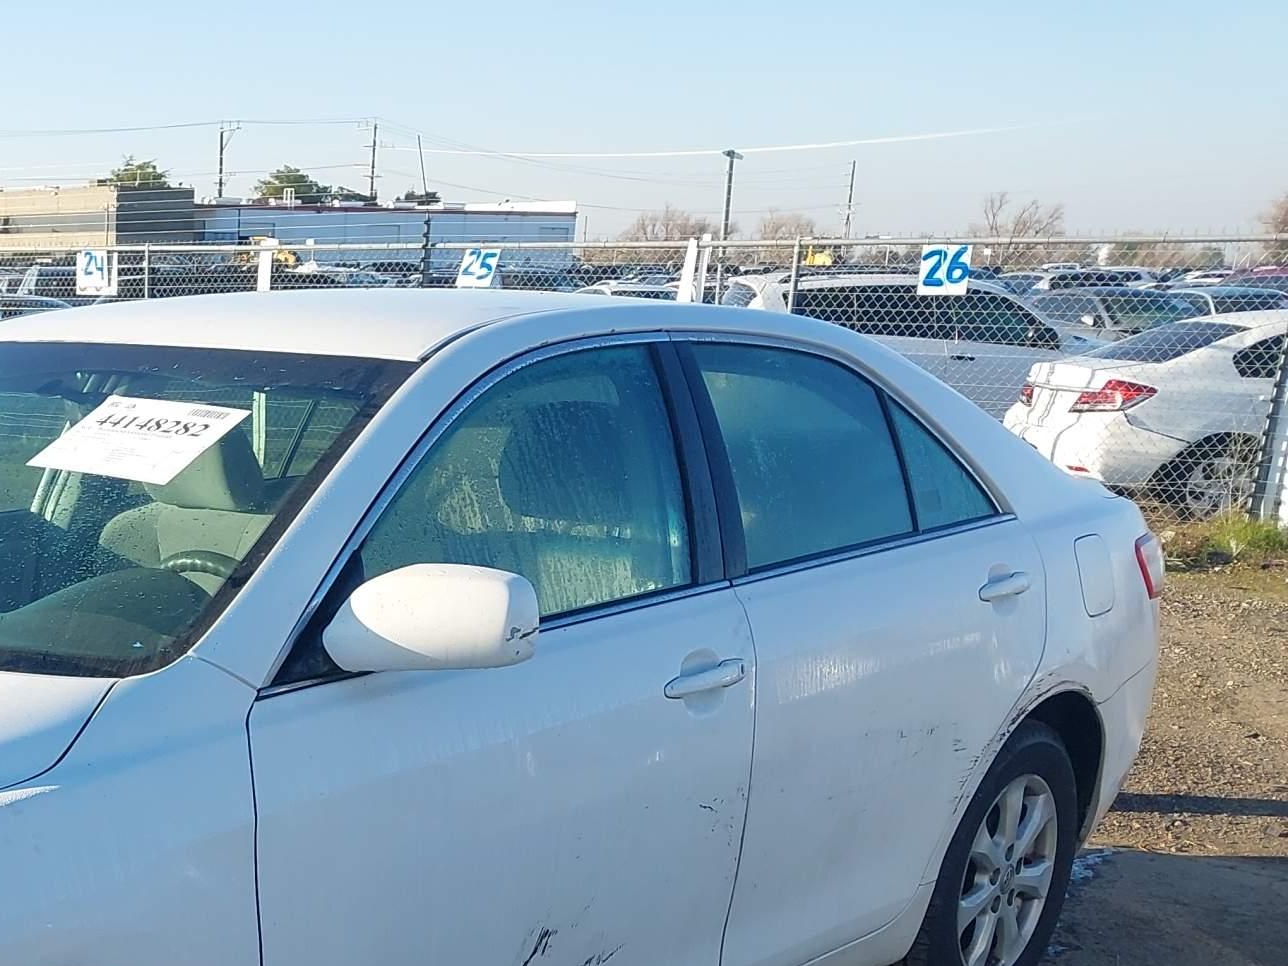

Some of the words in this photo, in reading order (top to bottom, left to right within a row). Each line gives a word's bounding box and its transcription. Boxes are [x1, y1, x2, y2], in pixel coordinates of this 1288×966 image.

[84, 251, 104, 280] 24
[462, 248, 498, 280] 25
[922, 244, 969, 287] 26
[96, 413, 210, 437] 44148282
